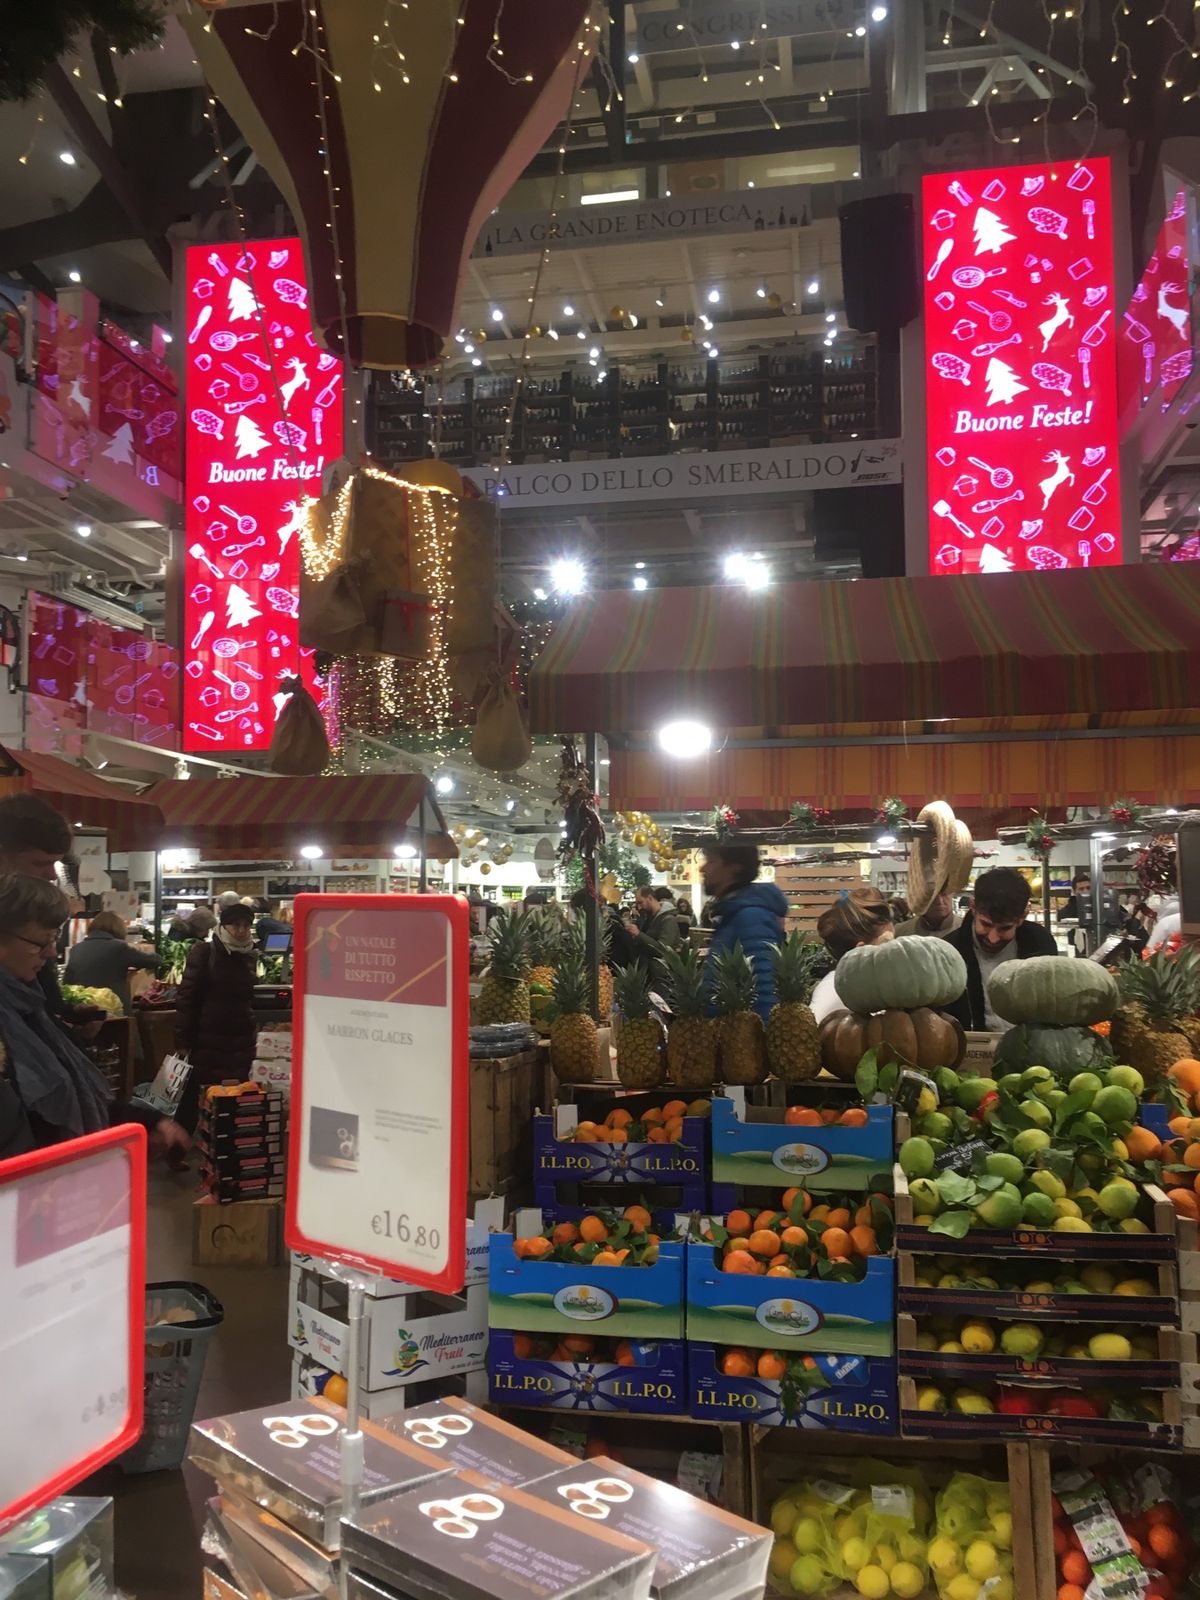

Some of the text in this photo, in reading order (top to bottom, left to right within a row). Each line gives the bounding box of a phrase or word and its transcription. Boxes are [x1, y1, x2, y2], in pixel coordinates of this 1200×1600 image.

[642, 9, 801, 42] CONGRESSI
[495, 203, 753, 245] LA GRANDE ENOTECA
[954, 400, 1093, 433] Buone Feste!
[208, 456, 324, 483] Buone Feste!
[483, 454, 847, 497] PALCO DELLO SMERALDO
[359, 936, 397, 949] NATALE
[344, 951, 397, 967] DI TUTTO
[344, 968, 397, 985] RISPETTO
[327, 1023, 369, 1040] MARRON
[540, 1155, 700, 1172] I.L.P.O. I.L.P.O.
[420, 1331, 485, 1351] Mediterraneo
[495, 1373, 556, 1392] I.L.P.O.
[613, 1381, 677, 1399] I.L.P.O.
[696, 1389, 890, 1420] I.L.P.O. I.L.P.O.
